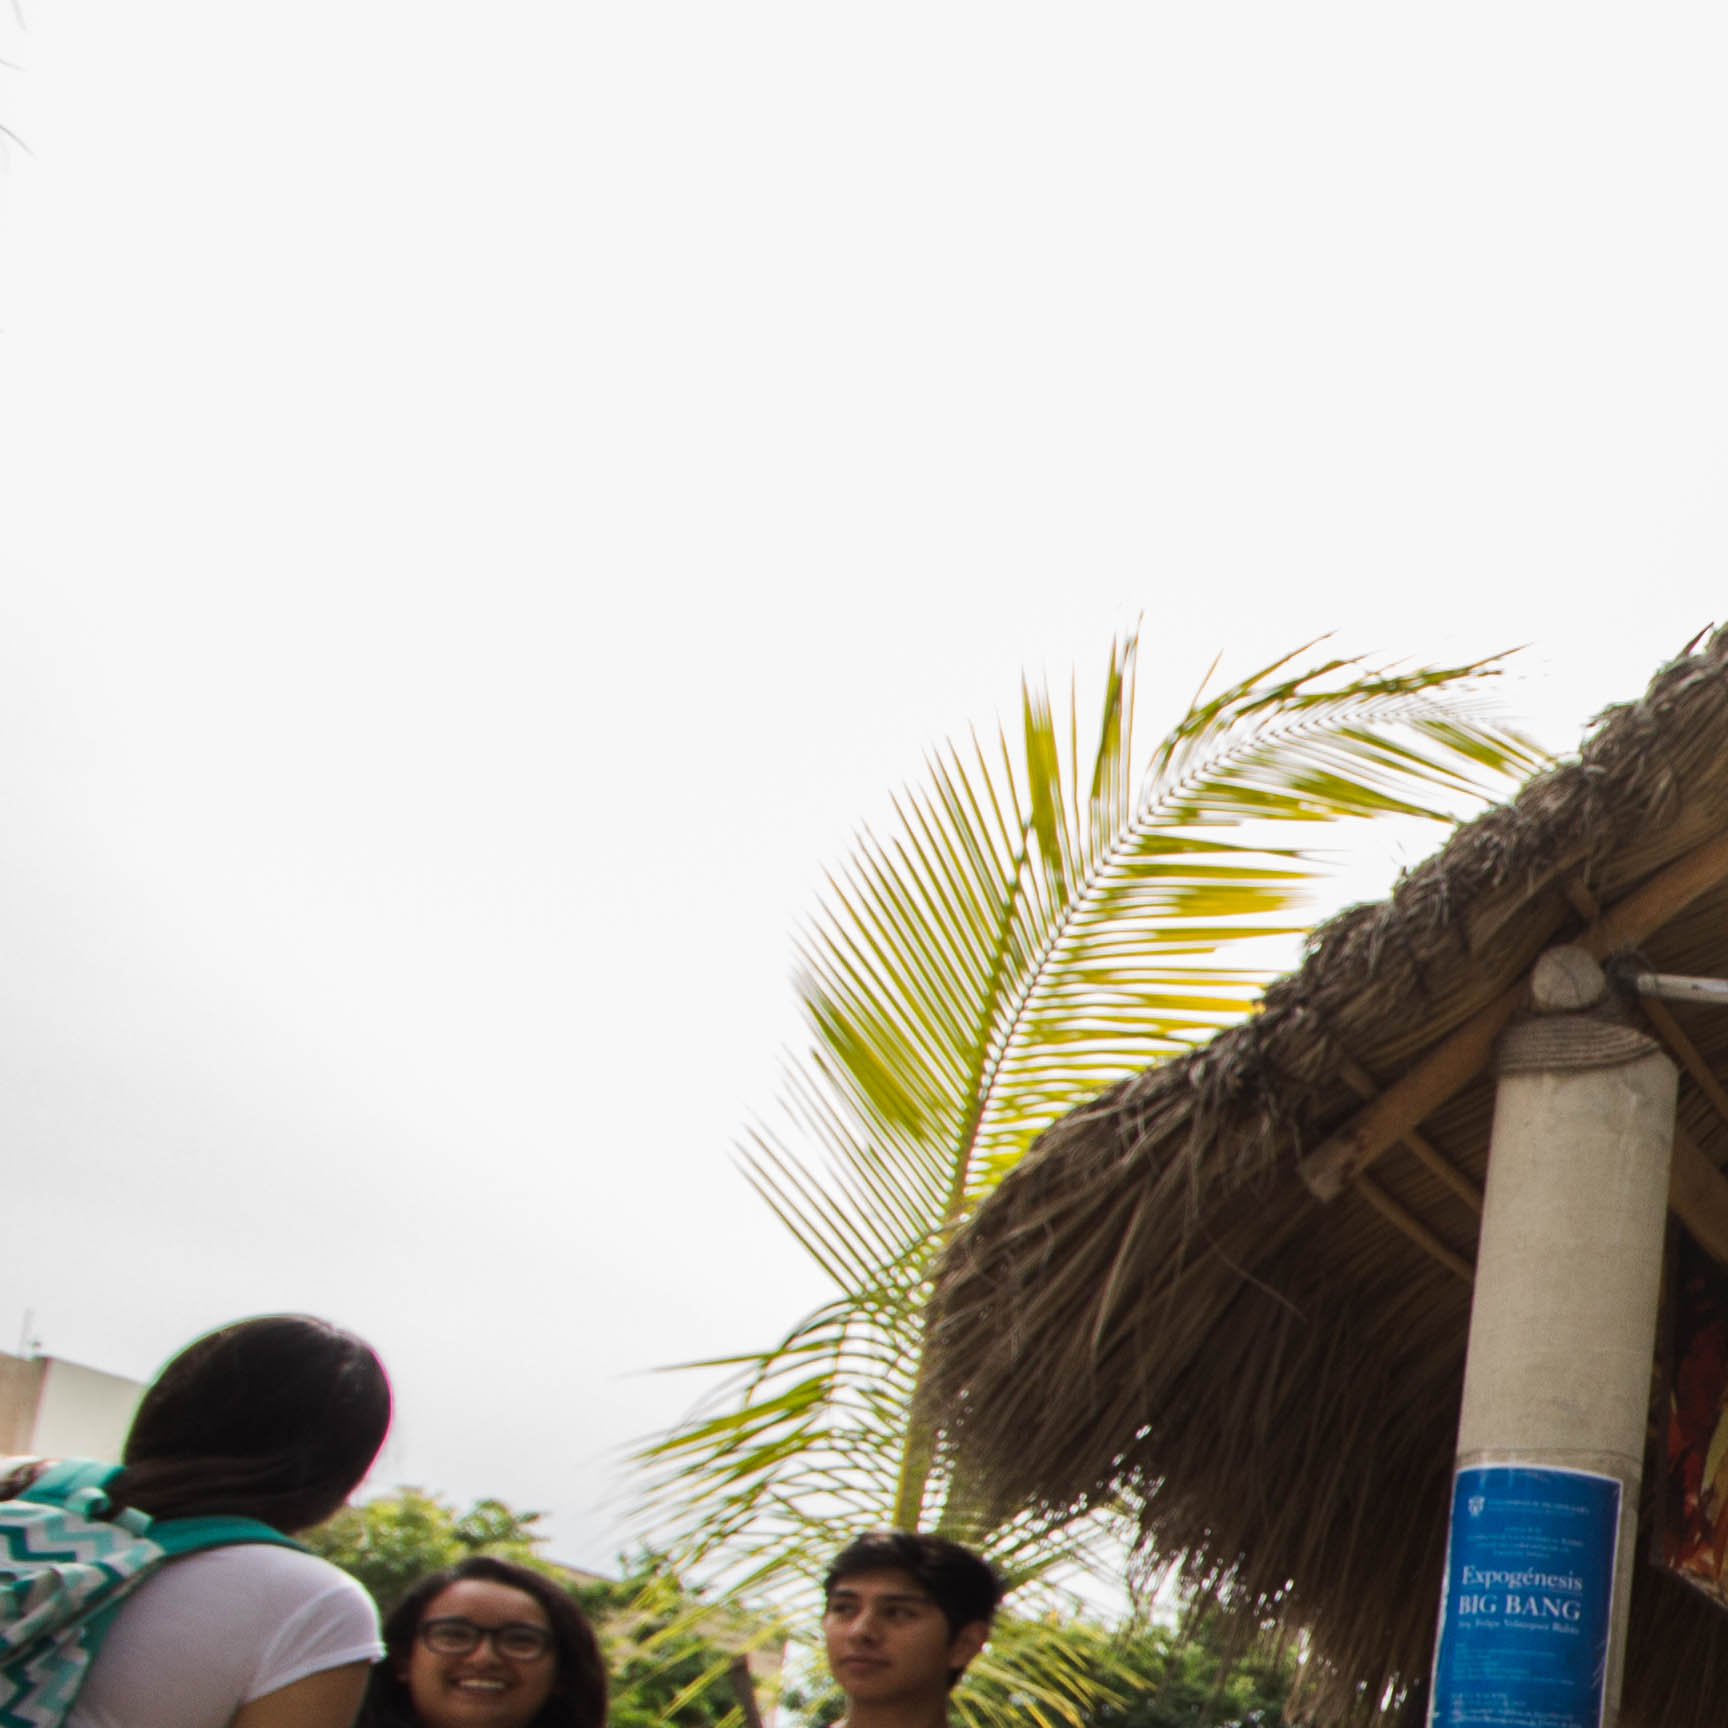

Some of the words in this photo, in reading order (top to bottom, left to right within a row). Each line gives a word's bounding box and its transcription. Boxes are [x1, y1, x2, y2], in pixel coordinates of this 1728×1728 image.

[1461, 1565, 1583, 1592] Expogénesis
[1458, 1593, 1498, 1616] BIG
[1504, 1593, 1582, 1622] BANG
